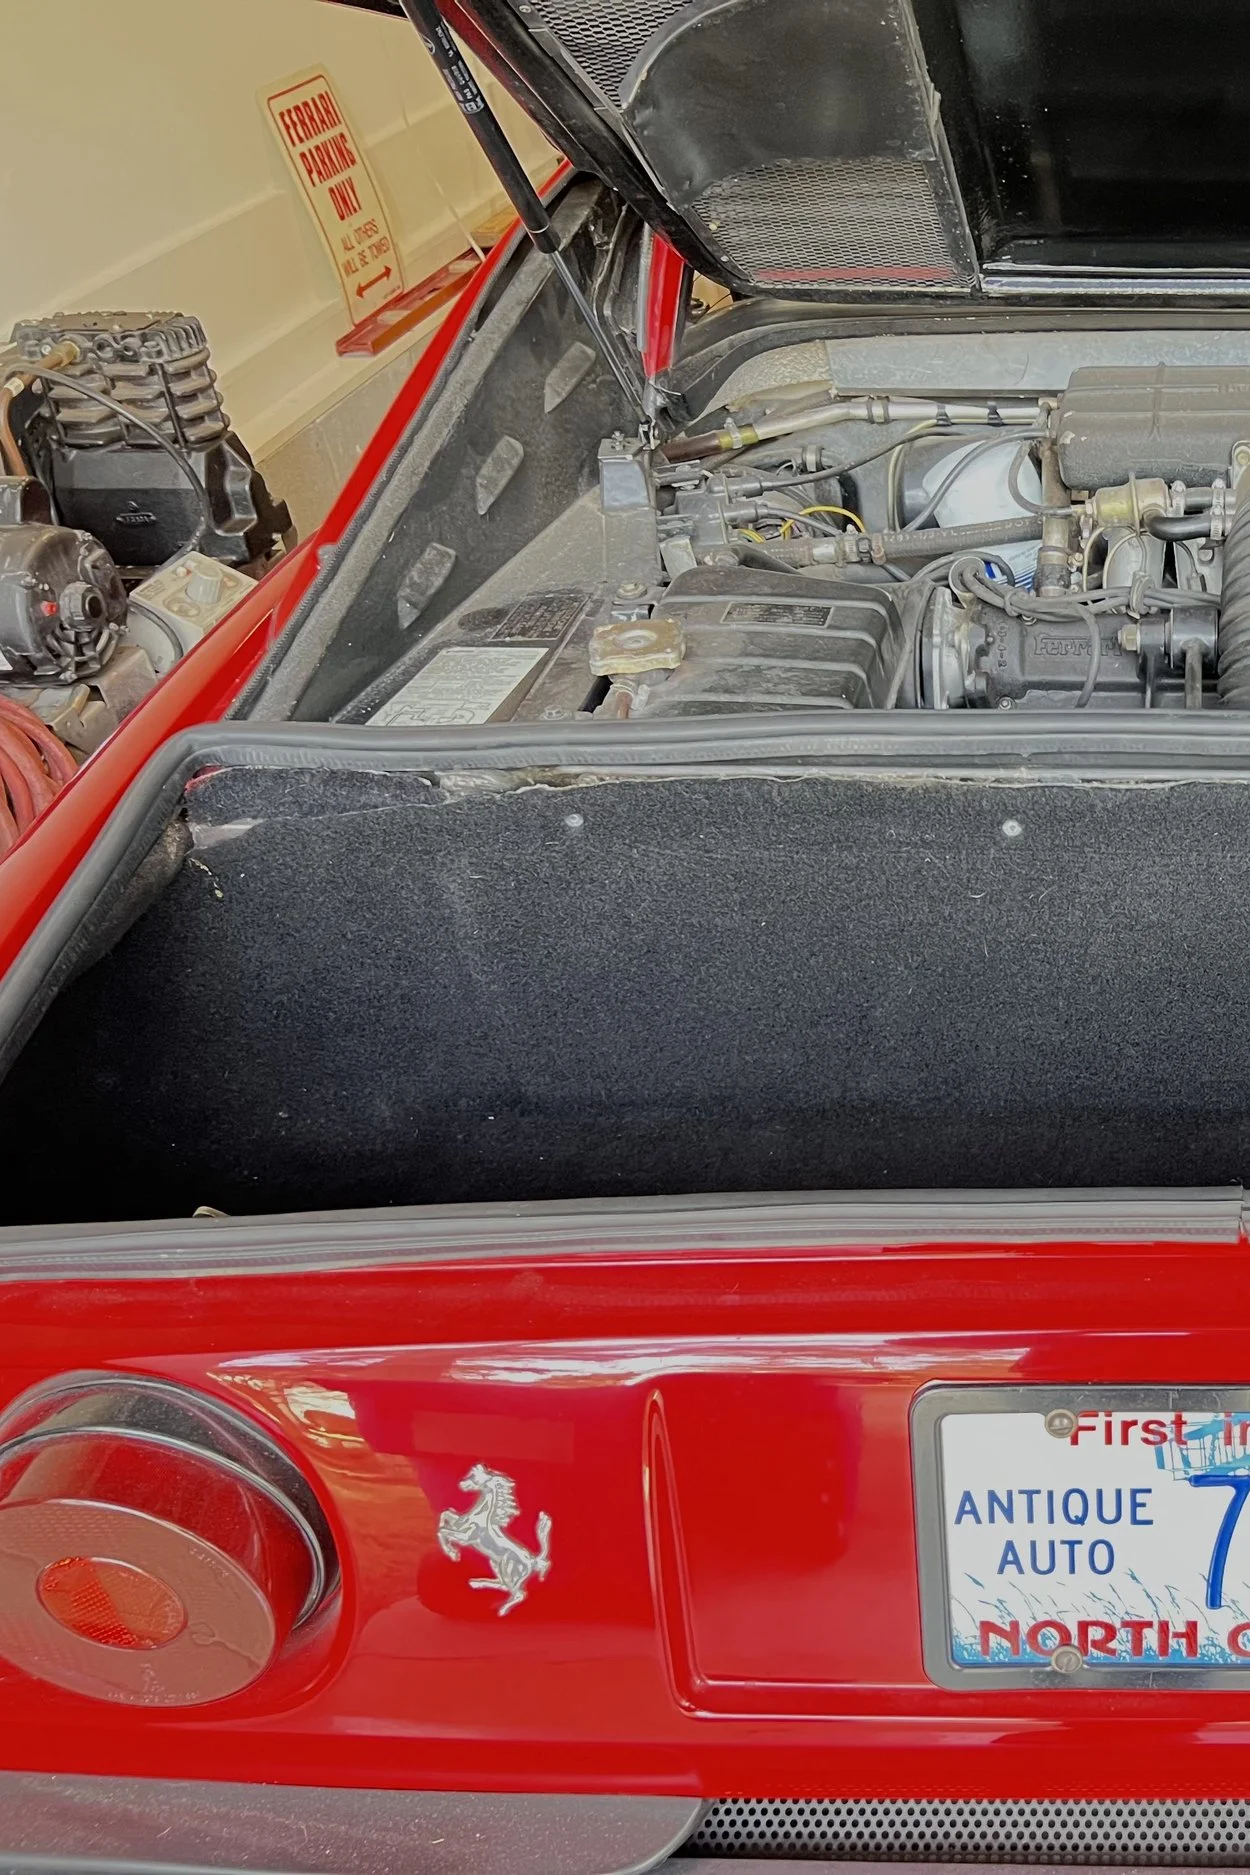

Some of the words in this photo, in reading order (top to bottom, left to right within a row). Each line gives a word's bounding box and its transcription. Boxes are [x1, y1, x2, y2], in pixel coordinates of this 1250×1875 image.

[278, 90, 342, 147] FERRARI
[328, 176, 362, 221] ONLY
[1069, 1411, 1187, 1447] First
[954, 1488, 1154, 1526] ANTIQUE
[997, 1539, 1115, 1575] AUTO
[979, 1619, 1198, 1657] NORTH
